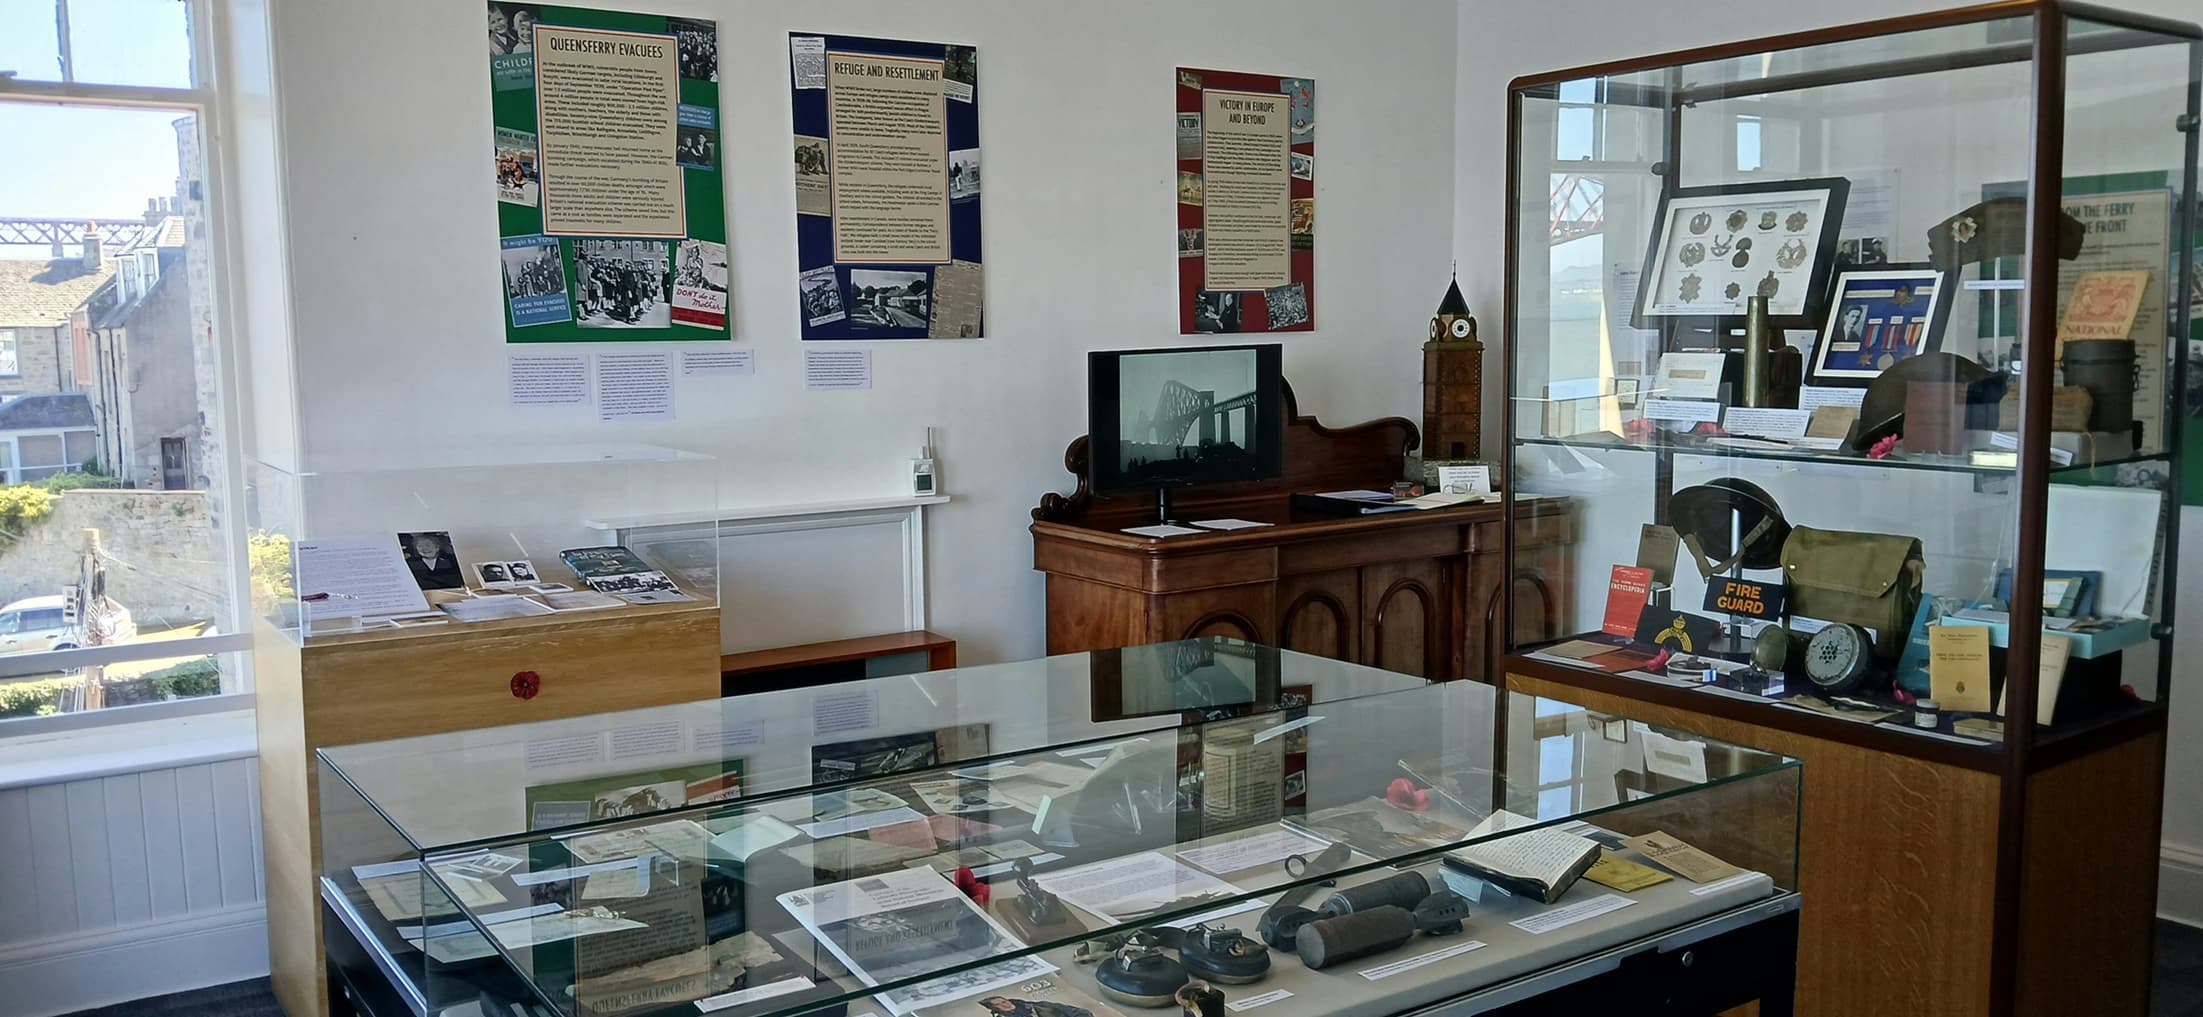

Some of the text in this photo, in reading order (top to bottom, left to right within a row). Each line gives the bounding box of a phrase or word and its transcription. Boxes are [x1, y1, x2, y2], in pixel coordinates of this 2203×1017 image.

[550, 37, 664, 59] QUEENSFERRY EVACUEES
[834, 62, 940, 82] REFUGE AND RESETTLEMENT
[1220, 99, 1275, 112] VICTORY IN EUROPE
[1228, 114, 1266, 126] AND BEYOND
[2084, 204, 2100, 217] THE
[2104, 202, 2135, 216] FERRY
[2096, 219, 2127, 233] FRONT
[2066, 326, 2122, 334] NATIONAL
[1726, 582, 1762, 599] FIRE
[1717, 596, 1764, 614] GUARD
